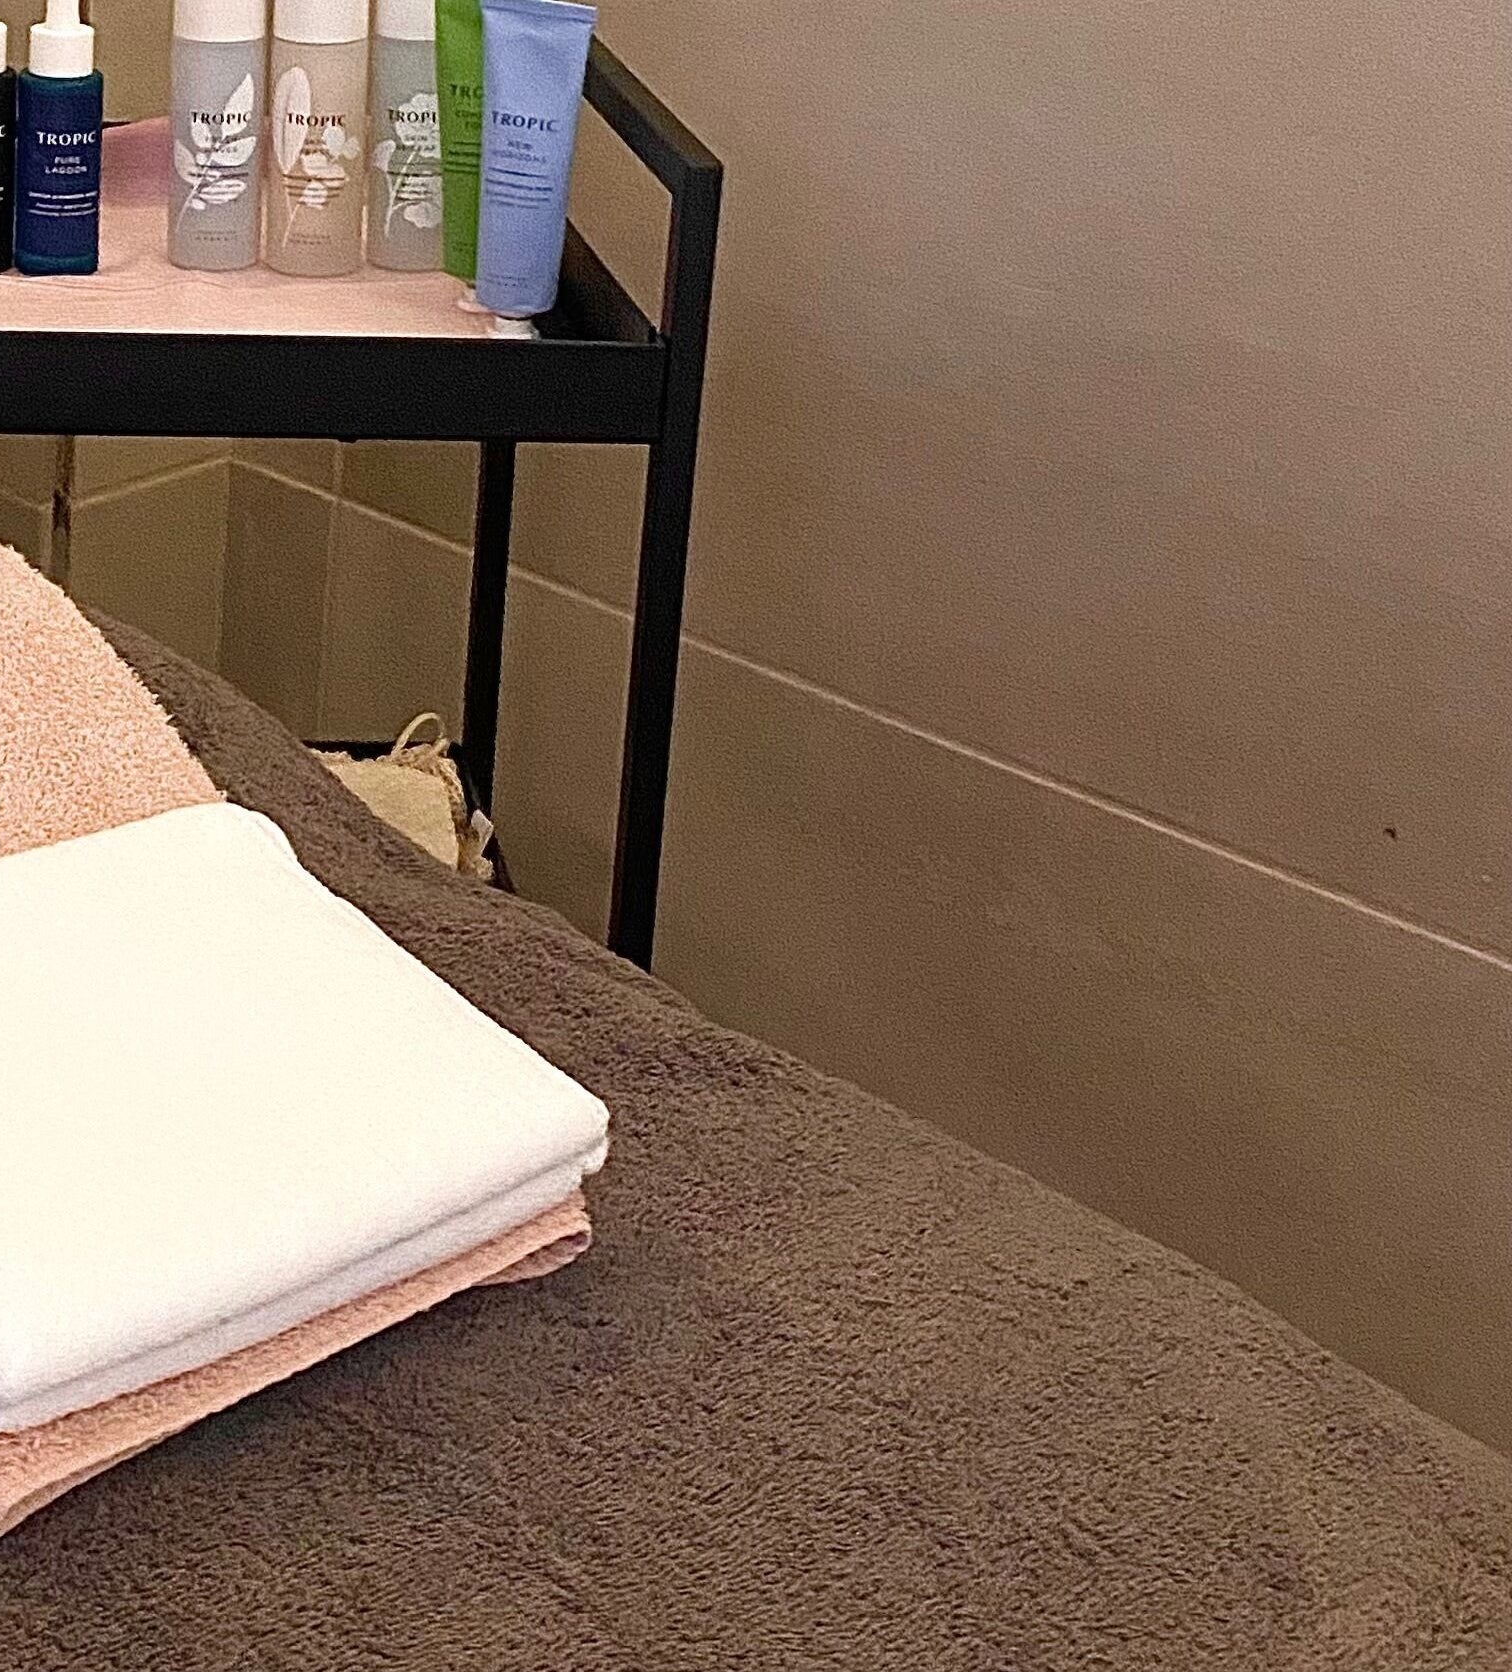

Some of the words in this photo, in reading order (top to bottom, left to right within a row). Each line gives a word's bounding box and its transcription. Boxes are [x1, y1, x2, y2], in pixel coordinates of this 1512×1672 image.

[191, 112, 251, 126] TROPIC
[288, 113, 346, 127] TROPIC
[388, 109, 437, 124] TROPI
[491, 110, 560, 133] TROPIC
[36, 130, 96, 146] TROPIC
[54, 156, 81, 165] PURE
[45, 165, 88, 174] LAGOON
